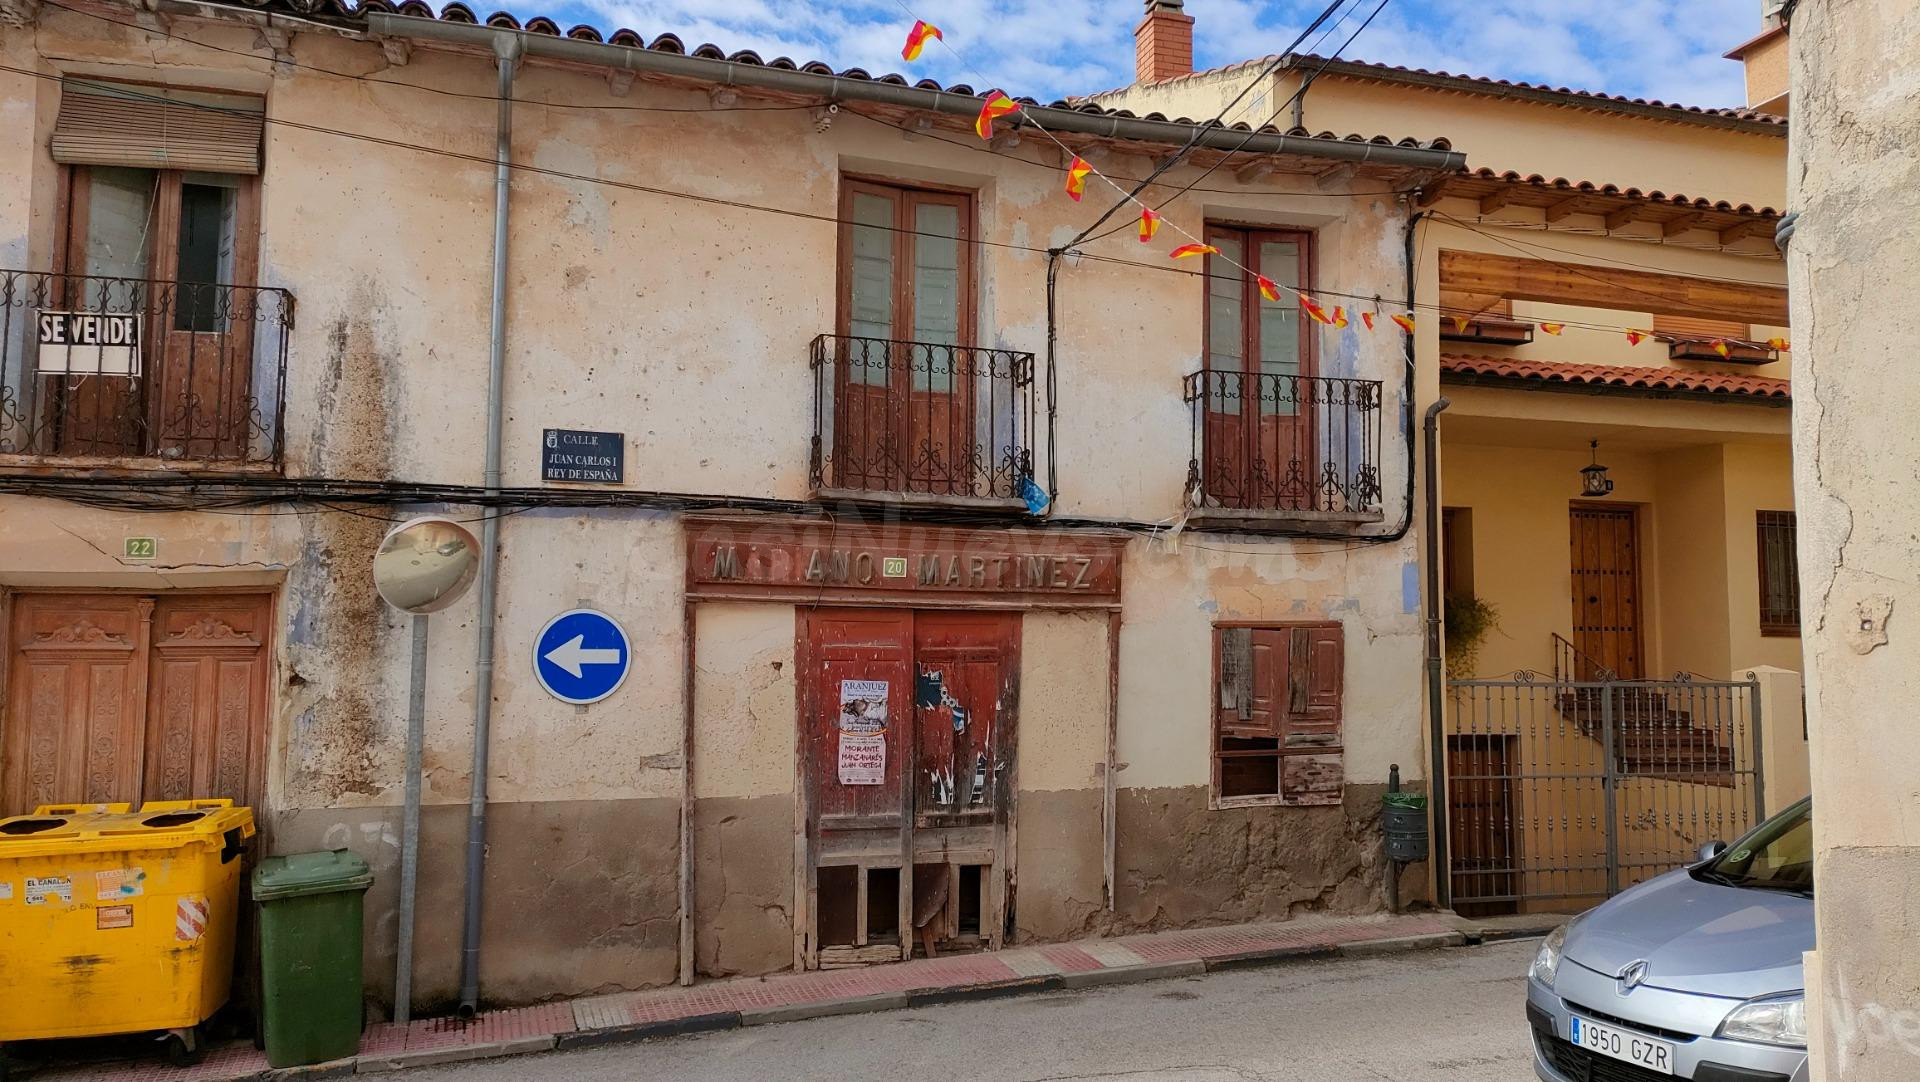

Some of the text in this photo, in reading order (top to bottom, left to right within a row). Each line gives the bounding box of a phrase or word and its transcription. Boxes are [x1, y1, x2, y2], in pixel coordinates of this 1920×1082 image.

[41, 315, 136, 344] SE VENDE
[564, 434, 599, 445] CALLE
[549, 453, 617, 467] JUAN CARLOS I
[547, 467, 618, 481] REY DE ESPAÑA
[130, 541, 151, 555] 22
[712, 545, 1092, 590] MANO MARTINEZ
[888, 561, 903, 574] 20
[843, 681, 887, 692] ARANJUEZ
[844, 744, 880, 753] MORANTE
[841, 761, 882, 769] JUAN ORTEGA
[27, 879, 35, 887] EL
[1582, 1023, 1668, 1070] 1950 GZR
